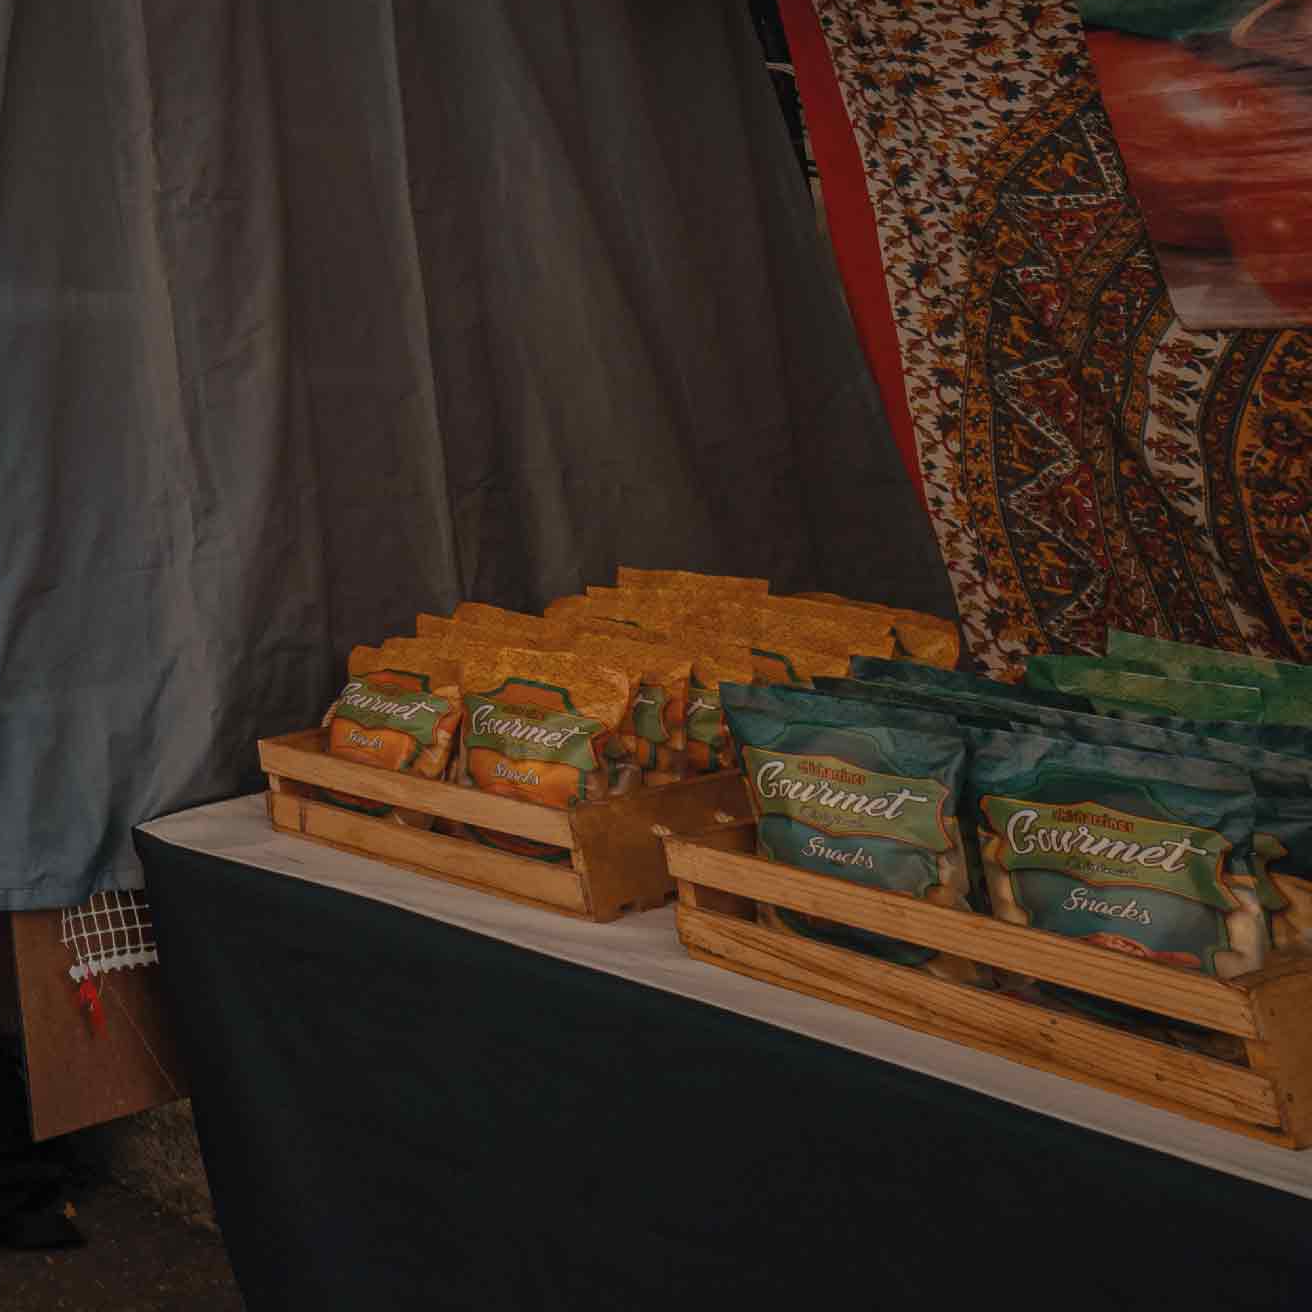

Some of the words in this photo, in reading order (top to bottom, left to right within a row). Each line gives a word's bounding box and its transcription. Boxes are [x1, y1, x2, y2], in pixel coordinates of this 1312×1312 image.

[340, 682, 436, 721] Gourmet
[472, 704, 590, 749] Gourmet
[495, 763, 540, 786] Snacks
[757, 760, 929, 821] Gourmet
[800, 836, 874, 870] Snacks
[1006, 809, 1208, 873] Gourmet
[1063, 887, 1153, 926] Snacks
